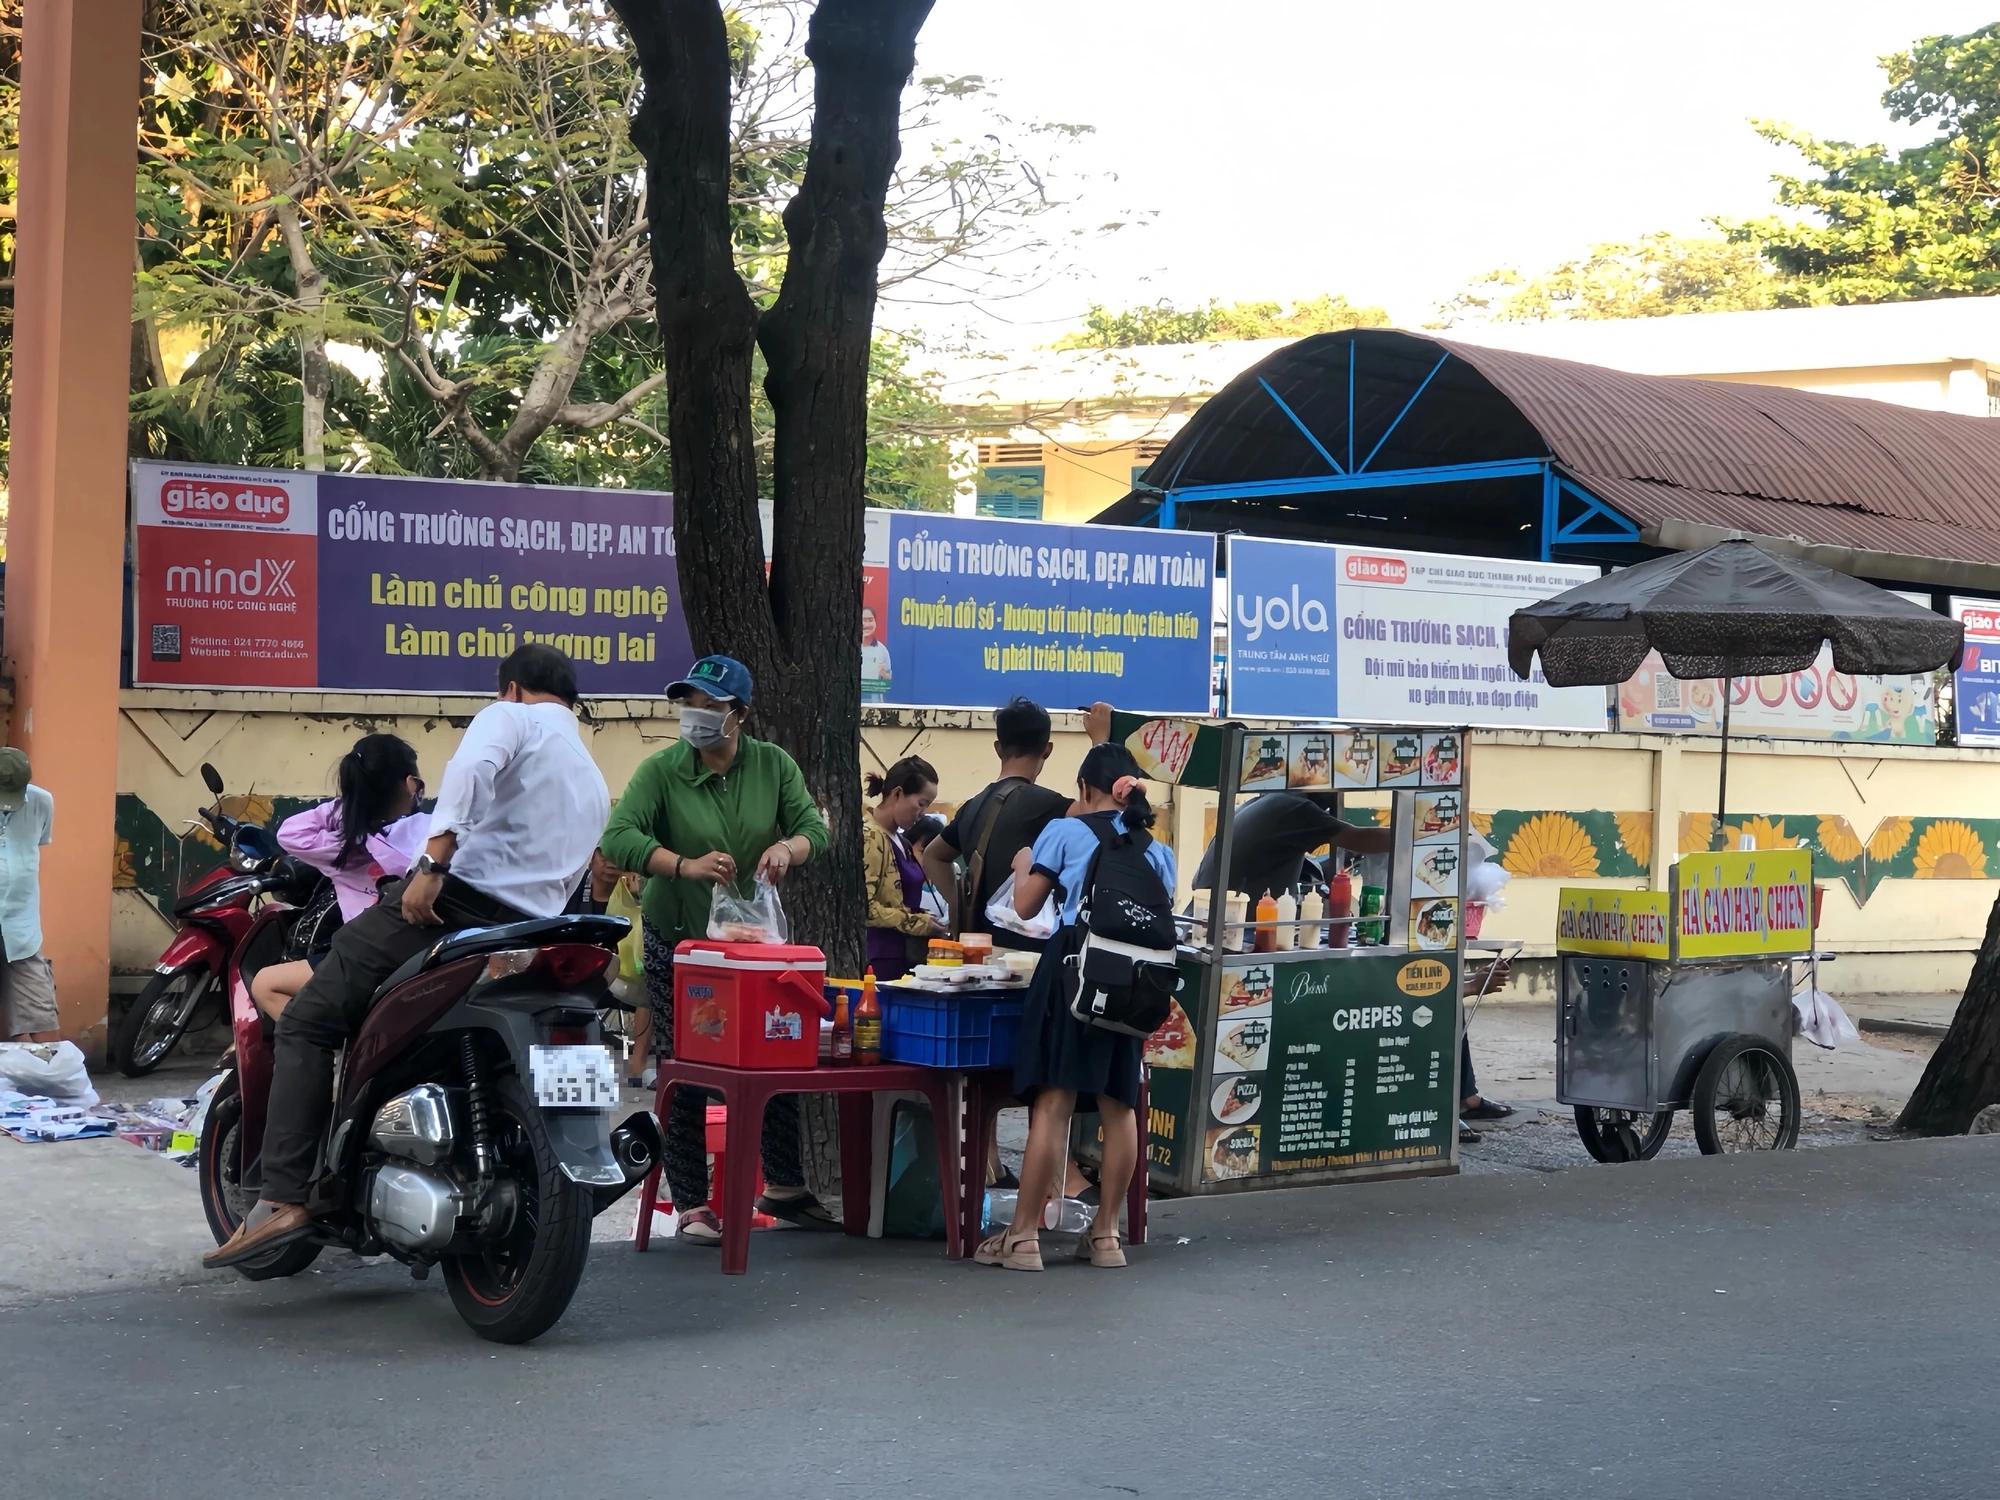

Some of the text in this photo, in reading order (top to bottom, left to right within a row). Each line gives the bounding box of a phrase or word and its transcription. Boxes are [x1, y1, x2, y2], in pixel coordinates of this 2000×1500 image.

[166, 484, 284, 518] giáo dục
[328, 500, 676, 559] CỔNG TRƯỜNG SẠCH, ĐẸP, AN TO
[166, 558, 296, 597] mindX
[898, 530, 1206, 590] CỔNG TRƯỜNG SẠCH, ĐẸP, AN TOÀN
[371, 573, 668, 623] Làm chủ công nghệ
[1237, 584, 1329, 642] yola
[901, 594, 952, 630] Chuyển
[954, 596, 977, 628] đổi
[978, 601, 996, 630] số
[1048, 604, 1065, 633] tới
[1067, 607, 1092, 640] một
[1094, 608, 1121, 638] giáo
[1123, 610, 1146, 642] dục
[1344, 611, 1386, 642] CỔNG
[1391, 618, 1452, 645] TRƯỜNG
[1456, 624, 1500, 650] SẠCH,
[386, 622, 450, 657] Làm
[458, 623, 516, 659] chủ
[618, 632, 656, 662] lai
[984, 640, 1124, 678] và phát triển bền vững
[1238, 650, 1268, 660] TRUNG
[1270, 650, 1287, 661] TÂM
[1288, 652, 1308, 662] ANH
[1366, 656, 1384, 680] Đội
[1386, 658, 1405, 676] mũ
[1408, 659, 1428, 679] bảo
[1431, 659, 1460, 680] hiểm
[1462, 664, 1479, 681] khi
[1481, 664, 1506, 685] ngồi
[1408, 685, 1538, 712] xe gắn máy, xe đạp điện
[1768, 869, 1809, 931] CHIÊN
[1631, 905, 1667, 944] CHIÊN
[1424, 966, 1442, 978] LINH
[1332, 1005, 1402, 1032] CREPES
[1237, 1084, 1258, 1096] PIZZA
